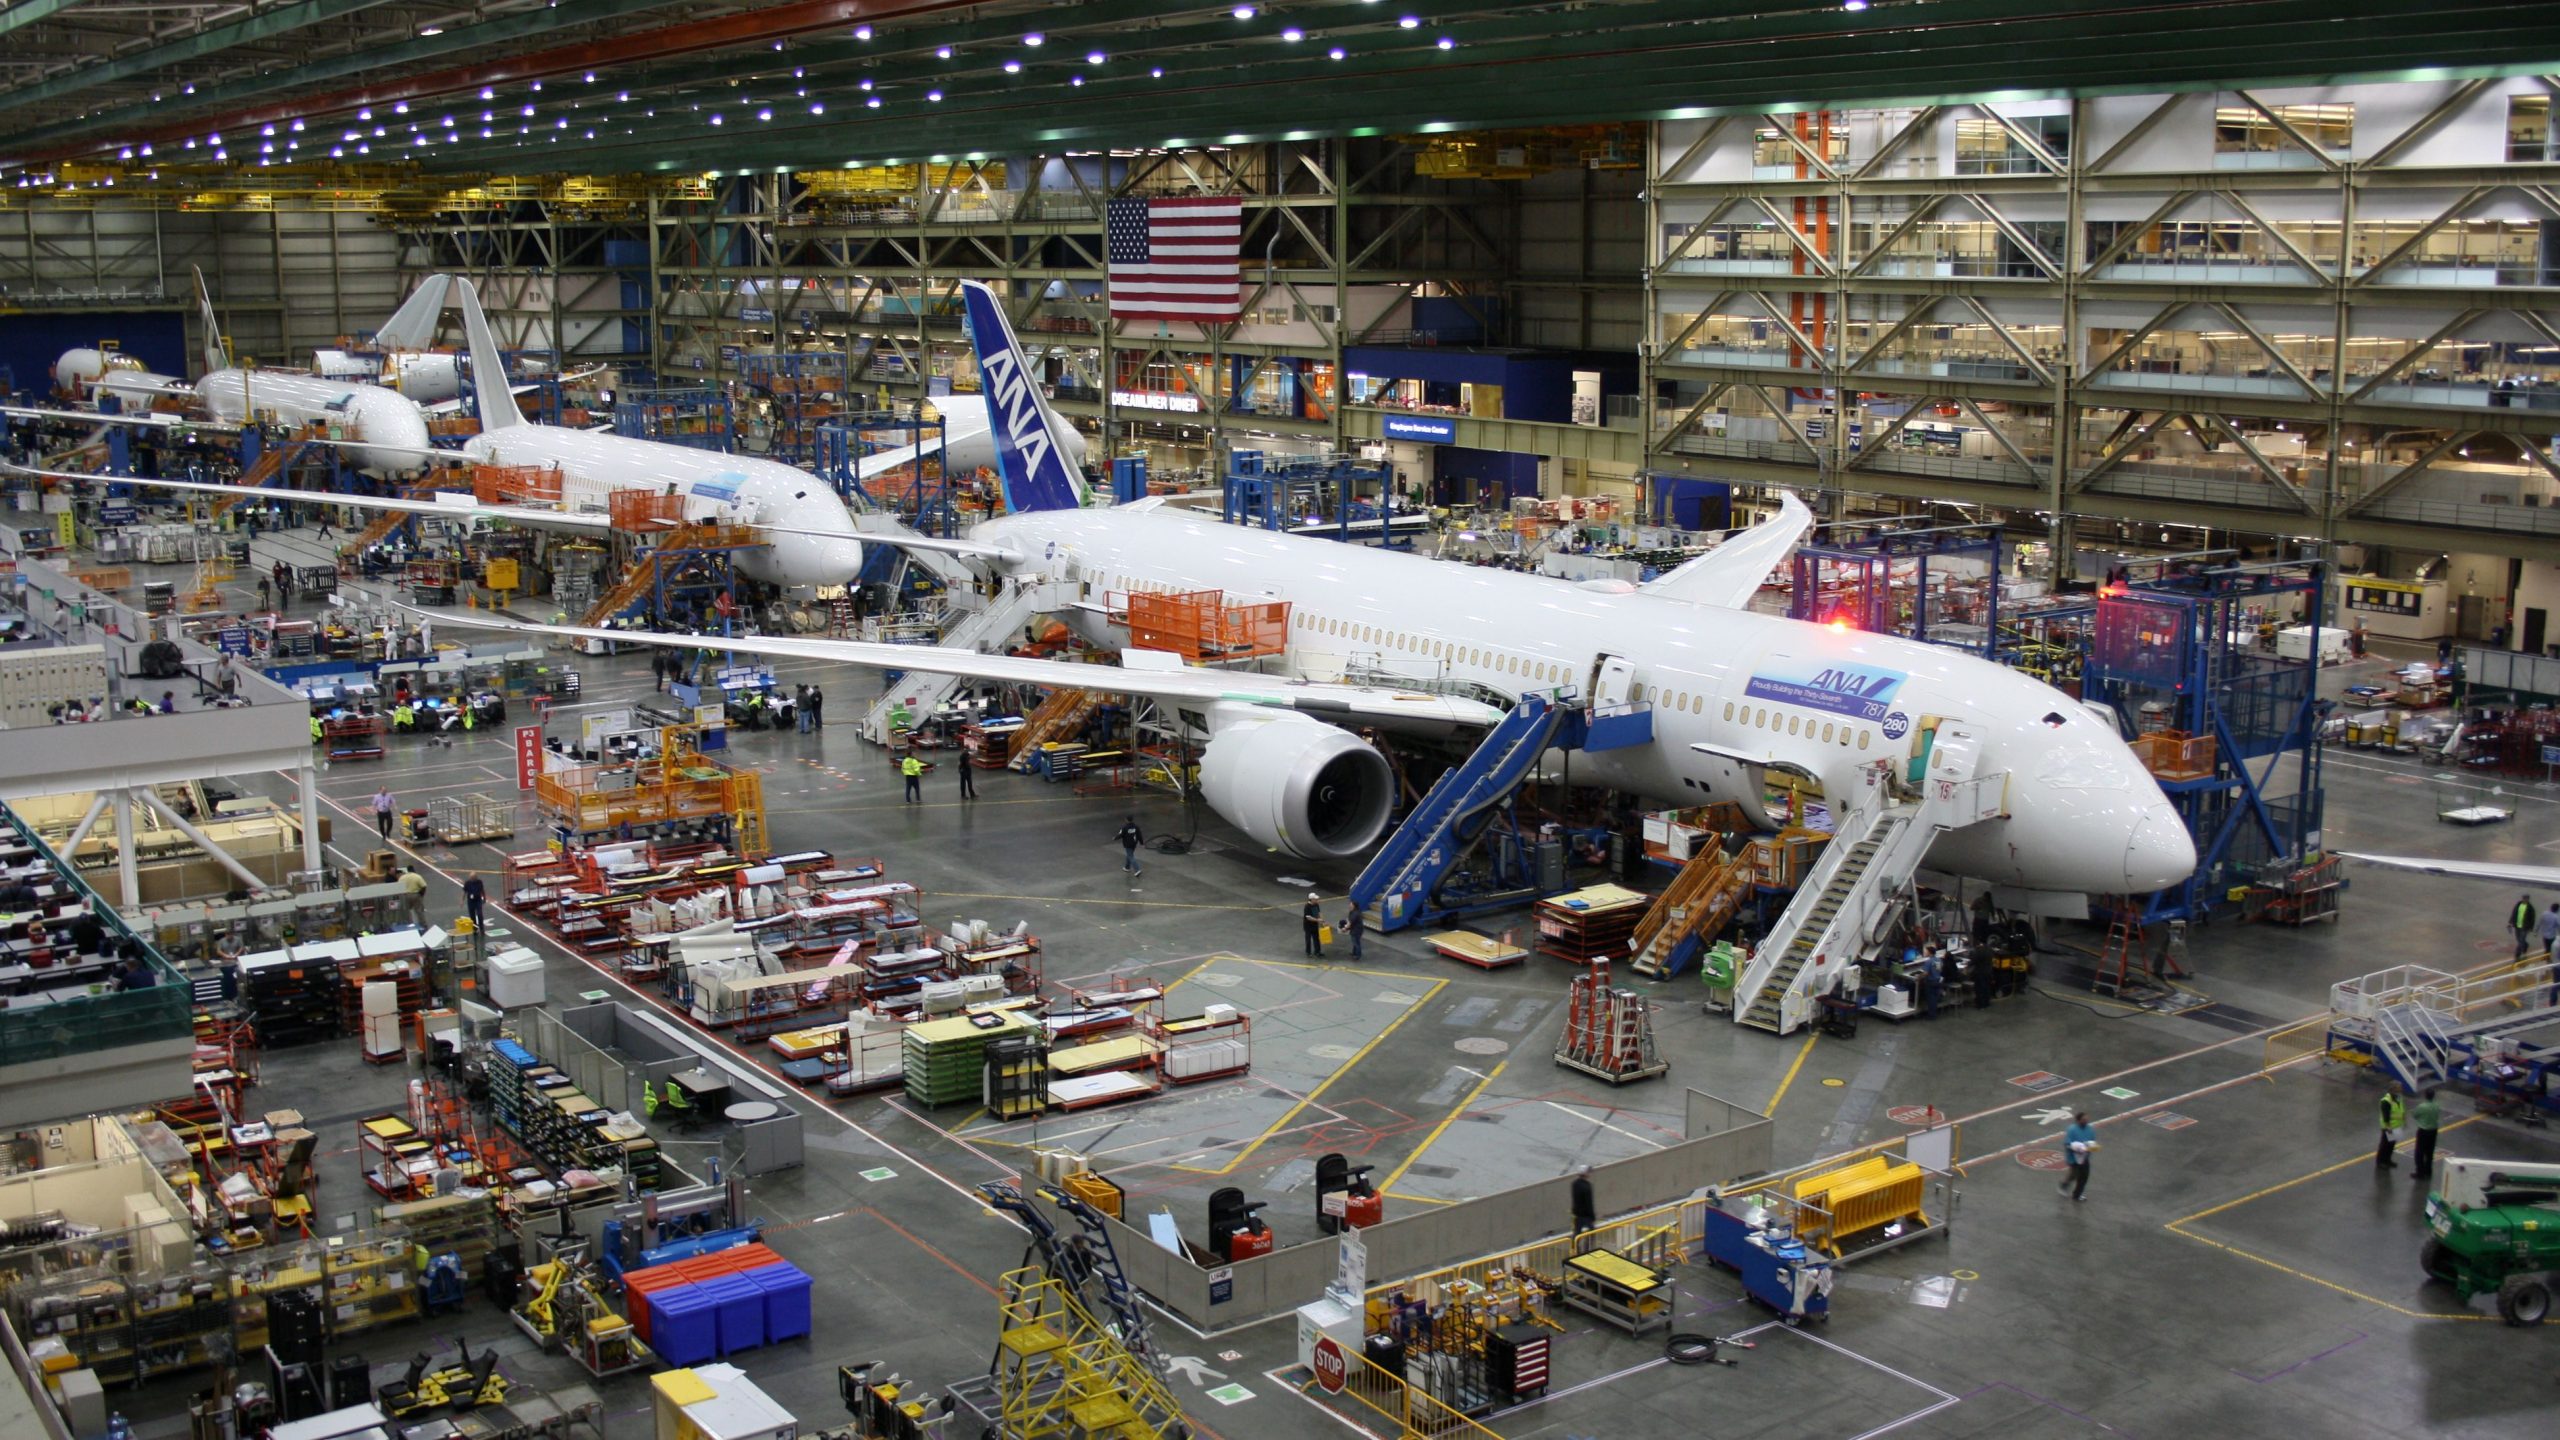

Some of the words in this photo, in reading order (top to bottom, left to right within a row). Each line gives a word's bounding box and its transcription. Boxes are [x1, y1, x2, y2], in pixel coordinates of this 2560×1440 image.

[1111, 391, 1168, 410] DREAMLINER
[1169, 396, 1199, 413] DINER
[982, 348, 1049, 483] ANA
[1807, 669, 1868, 697] ANA
[1862, 701, 1887, 717] 787
[523, 729, 534, 737] P3
[1883, 717, 1907, 732] 280
[525, 739, 536, 786] BARGE
[1316, 1347, 1343, 1376] STOP
